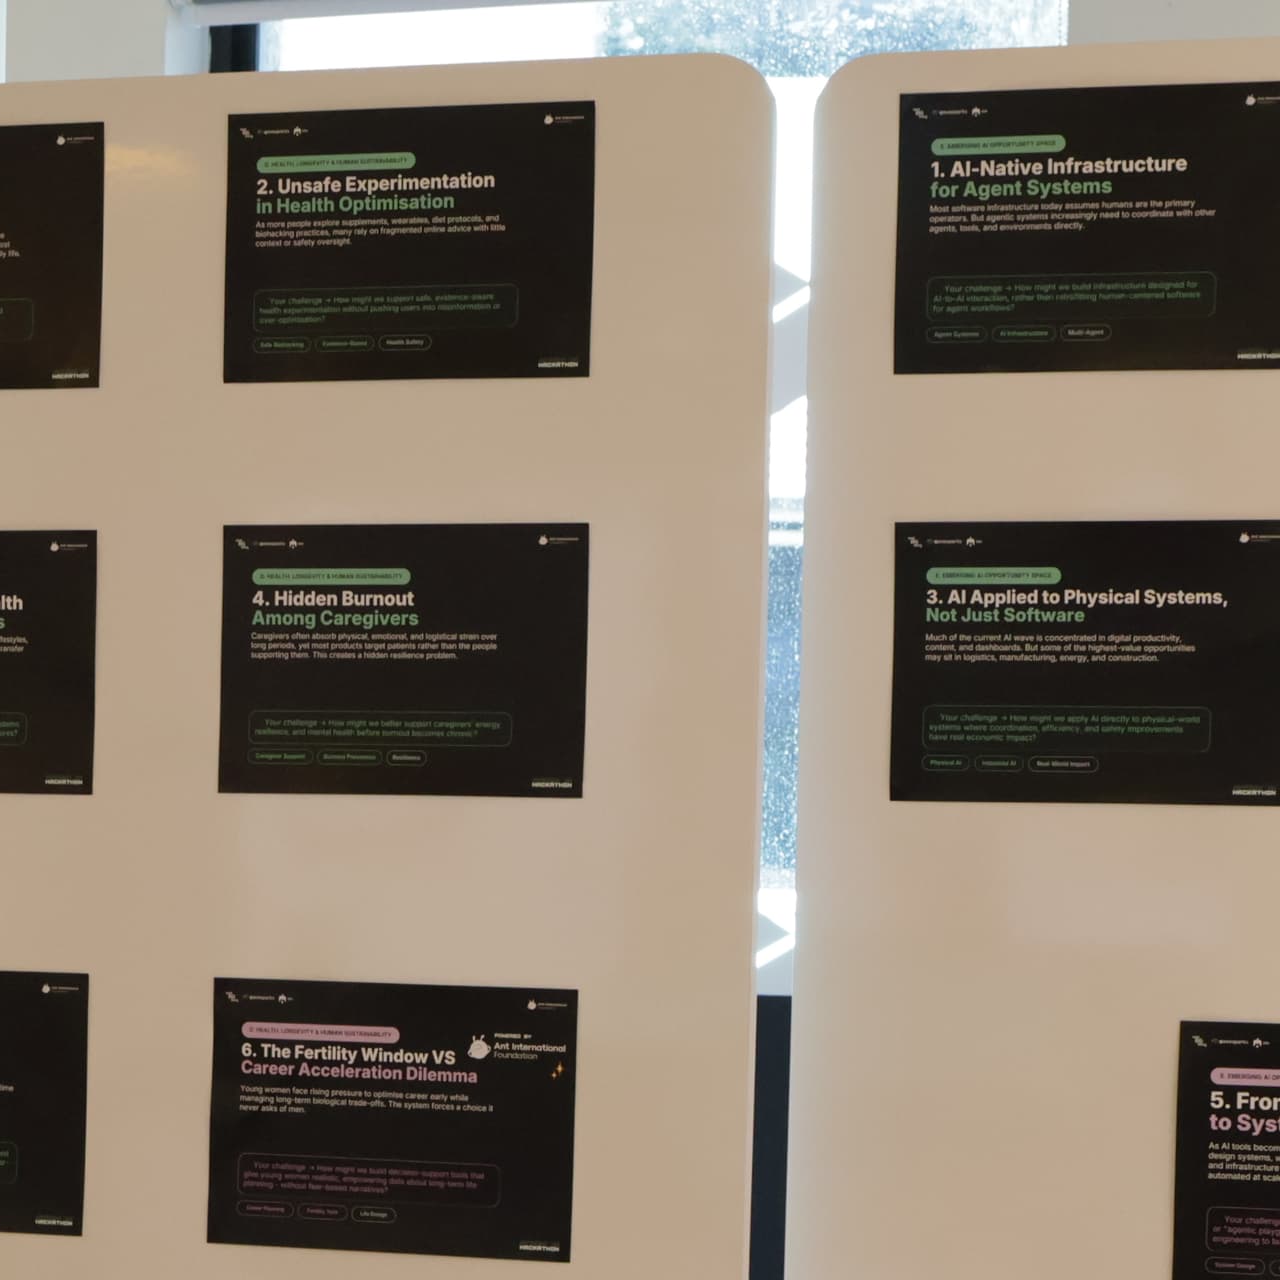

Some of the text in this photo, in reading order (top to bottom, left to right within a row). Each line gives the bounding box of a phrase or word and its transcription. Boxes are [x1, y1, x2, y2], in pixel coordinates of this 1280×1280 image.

[930, 155, 1188, 178] 1. AI-Native Infrastructure
[255, 171, 496, 195] 2. Unsafe Experimentation
[929, 178, 1113, 201] for Agent Systems
[255, 192, 455, 215] in Health Optimisation
[251, 589, 415, 607] 4. Hidden Burnout
[925, 588, 1228, 609] 3. AI Applied to Physical Systems,
[251, 608, 419, 630] Among Caregivers
[925, 607, 1085, 623] Not Just Software
[240, 1042, 456, 1065] 6. The Fertility Window VS
[492, 1041, 567, 1053] Ant International
[492, 1050, 538, 1060] Foundation
[240, 1059, 478, 1084] Career Acceleration Dilemma
[1209, 1090, 1231, 1109] 5.
[1208, 1113, 1280, 1136] to Sys
